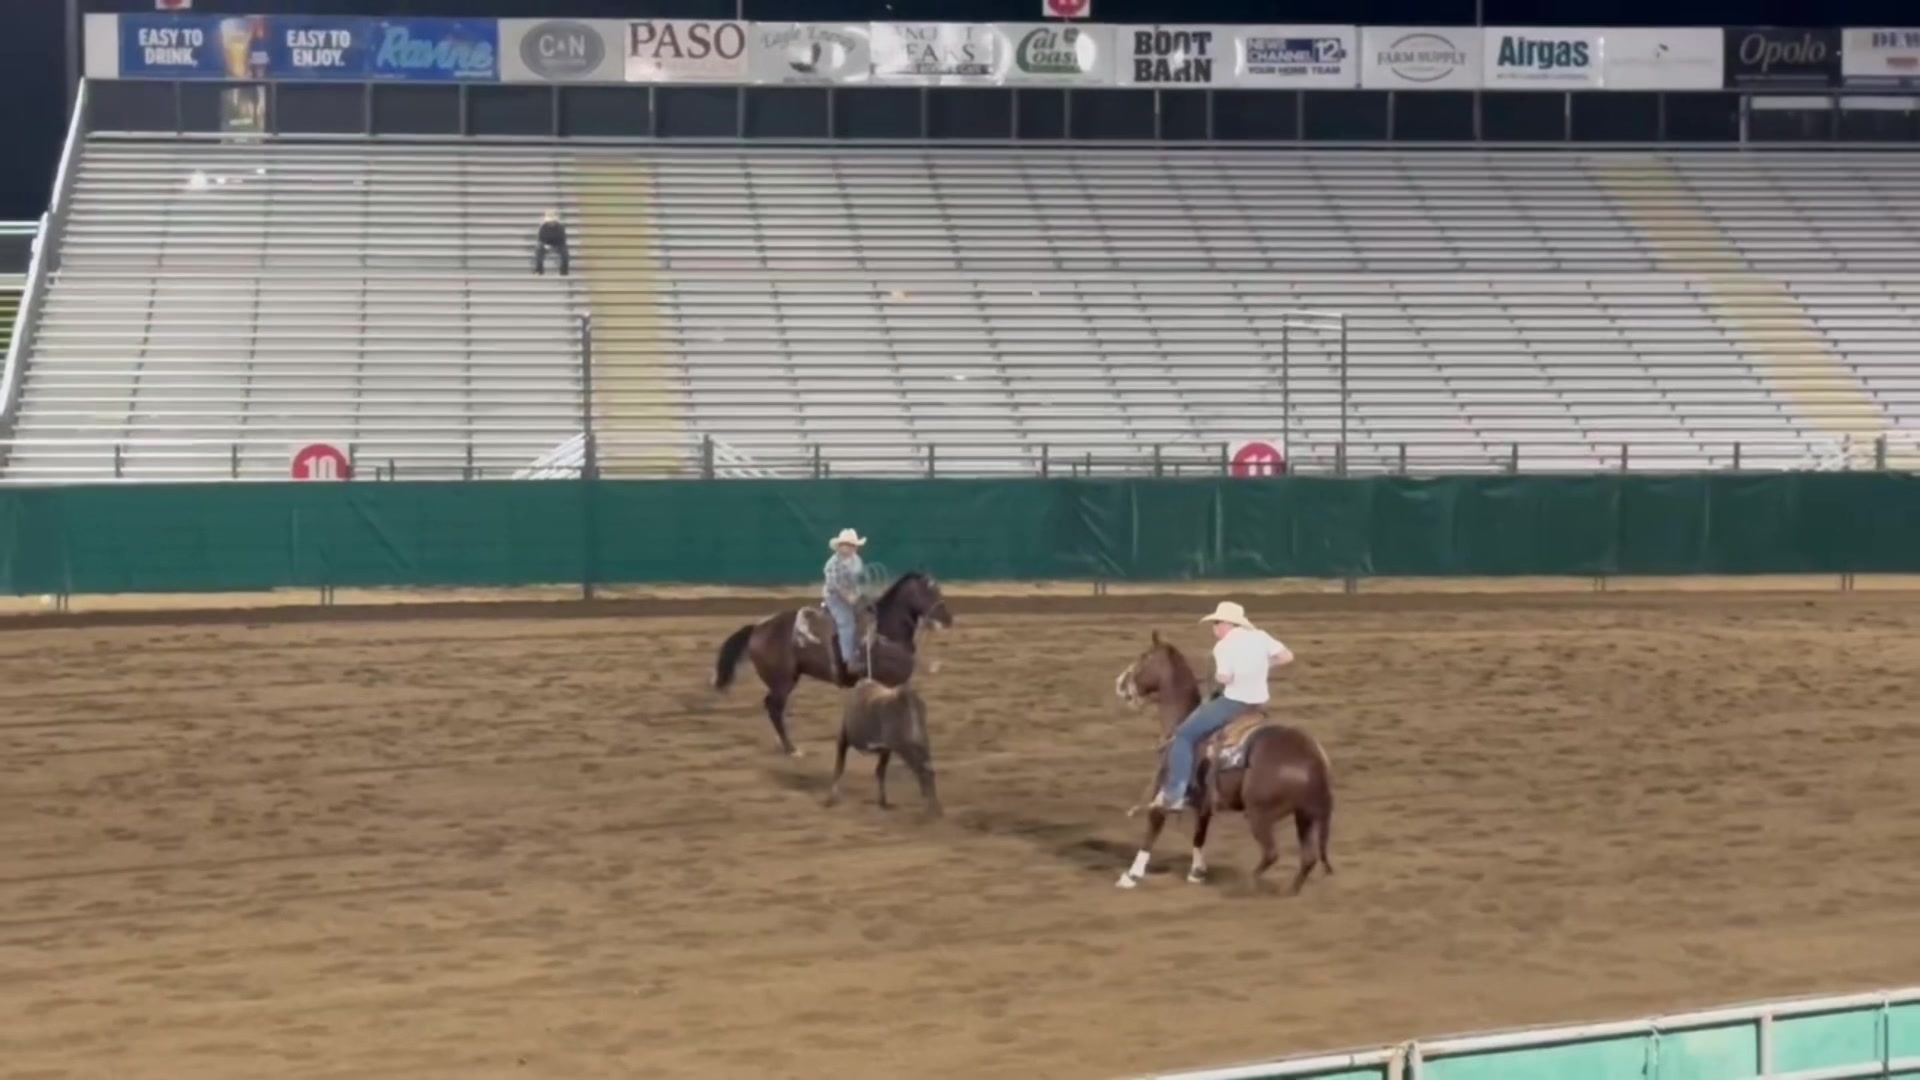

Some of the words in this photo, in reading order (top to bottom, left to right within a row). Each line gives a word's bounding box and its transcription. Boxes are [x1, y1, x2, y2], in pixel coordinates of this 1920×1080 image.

[138, 28, 178, 47] EASY
[183, 29, 204, 47] TO
[286, 30, 327, 48] EASY
[331, 30, 351, 49] TO
[629, 22, 746, 60] PASO
[1134, 31, 1212, 55] BOOT
[144, 48, 198, 67] DRINK,
[292, 49, 345, 67] ENJOY.
[1315, 39, 1341, 62] 12
[1497, 35, 1590, 69] Airgas
[1739, 33, 1826, 72] Opolo
[1134, 58, 1212, 82] BARN
[303, 455, 338, 480] 10
[1243, 454, 1272, 477] 11
